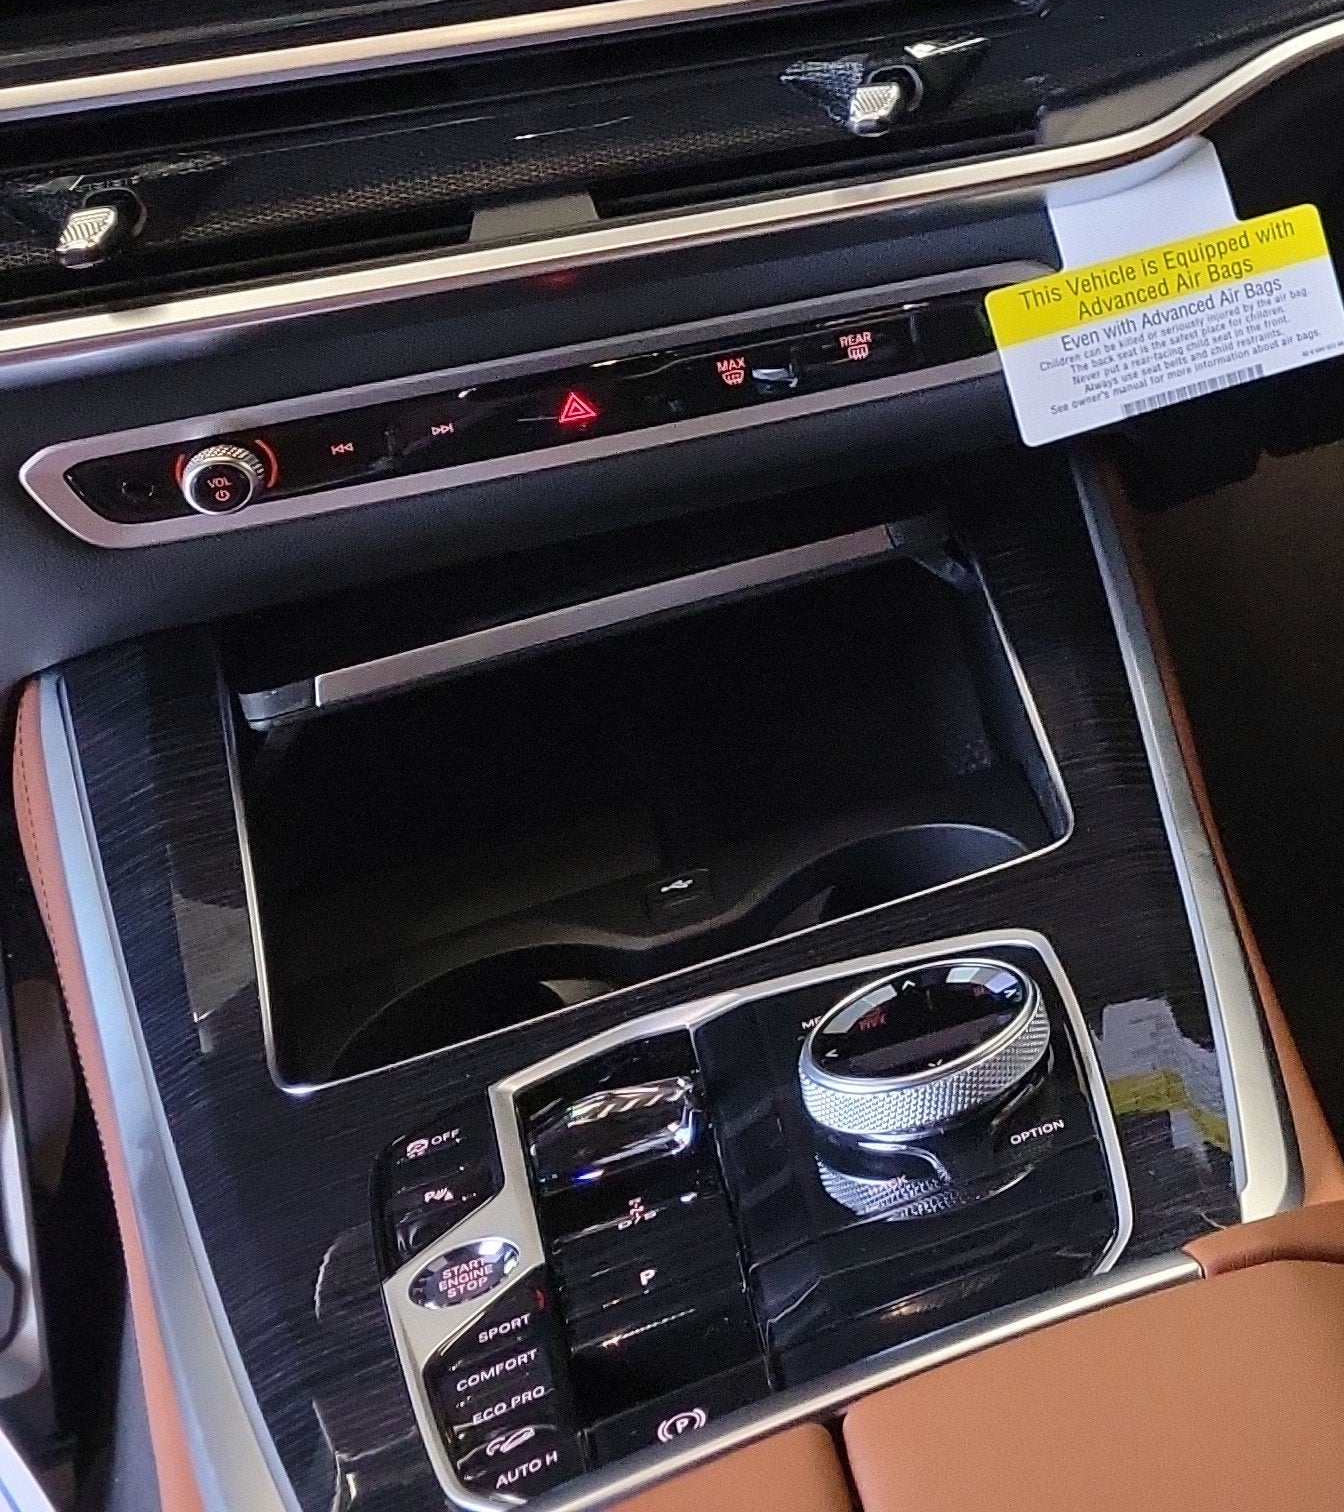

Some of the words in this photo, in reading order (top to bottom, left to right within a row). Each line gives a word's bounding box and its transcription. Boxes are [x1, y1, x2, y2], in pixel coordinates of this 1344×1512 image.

[1018, 286, 1062, 310] This
[1065, 265, 1136, 297] Vehicle
[1140, 258, 1158, 277] is
[1163, 230, 1250, 270] Equipped
[1255, 219, 1295, 244] with
[1079, 277, 1170, 321] Advanced
[1177, 270, 1201, 293] Air
[1207, 258, 1253, 283] Bags
[1039, 354, 1081, 372] Children
[1084, 348, 1101, 359] can
[1103, 344, 1116, 353] be
[1119, 333, 1145, 348] killed
[1147, 331, 1157, 340] or
[1160, 318, 1204, 337] seriously
[1207, 306, 1240, 322] injured
[1242, 304, 1254, 314] by
[1257, 298, 1272, 308] the
[1275, 294, 1286, 303] air
[1061, 331, 1100, 352] Even
[1103, 318, 1137, 339] with
[1142, 294, 1216, 329] Advanced
[1220, 288, 1239, 307] Air
[1243, 278, 1282, 299] Bags
[839, 331, 872, 348] REAR
[1070, 363, 1088, 373] The
[1091, 355, 1114, 368] back
[1117, 347, 1138, 360] seat
[1151, 340, 1166, 350] the
[1169, 330, 1198, 345] safest
[1201, 323, 1226, 338] place
[1228, 318, 1242, 327] for
[1072, 371, 1100, 385] Never
[1104, 364, 1120, 378] put
[1186, 338, 1210, 351] child
[1212, 331, 1232, 343] seat
[1246, 324, 1261, 333] the
[716, 356, 746, 372] MAX
[1050, 403, 1069, 415] See
[1072, 391, 1110, 409] owner's
[1113, 378, 1148, 396] manual
[1150, 374, 1164, 385] for
[1167, 367, 1192, 379] more
[1194, 349, 1250, 372] information
[1253, 340, 1279, 355] about
[1282, 336, 1293, 346] air
[1085, 377, 1118, 393] Always
[1122, 371, 1138, 382] use
[1163, 356, 1188, 369] belts
[1191, 350, 1208, 362] and
[1211, 341, 1234, 355] child
[207, 476, 232, 488] VOL
[431, 1128, 460, 1145] OFF
[1010, 1119, 1064, 1146] OPTION
[438, 1264, 493, 1291] ENGINE
[442, 1257, 485, 1279] START
[447, 1276, 488, 1298] STOP
[640, 1269, 655, 1286] P
[478, 1313, 530, 1344] SPORT
[456, 1348, 537, 1392] COMFORT
[472, 1401, 506, 1425] ECO
[511, 1385, 545, 1409] PRO
[496, 1458, 542, 1489] AUTO
[546, 1450, 558, 1467] H
